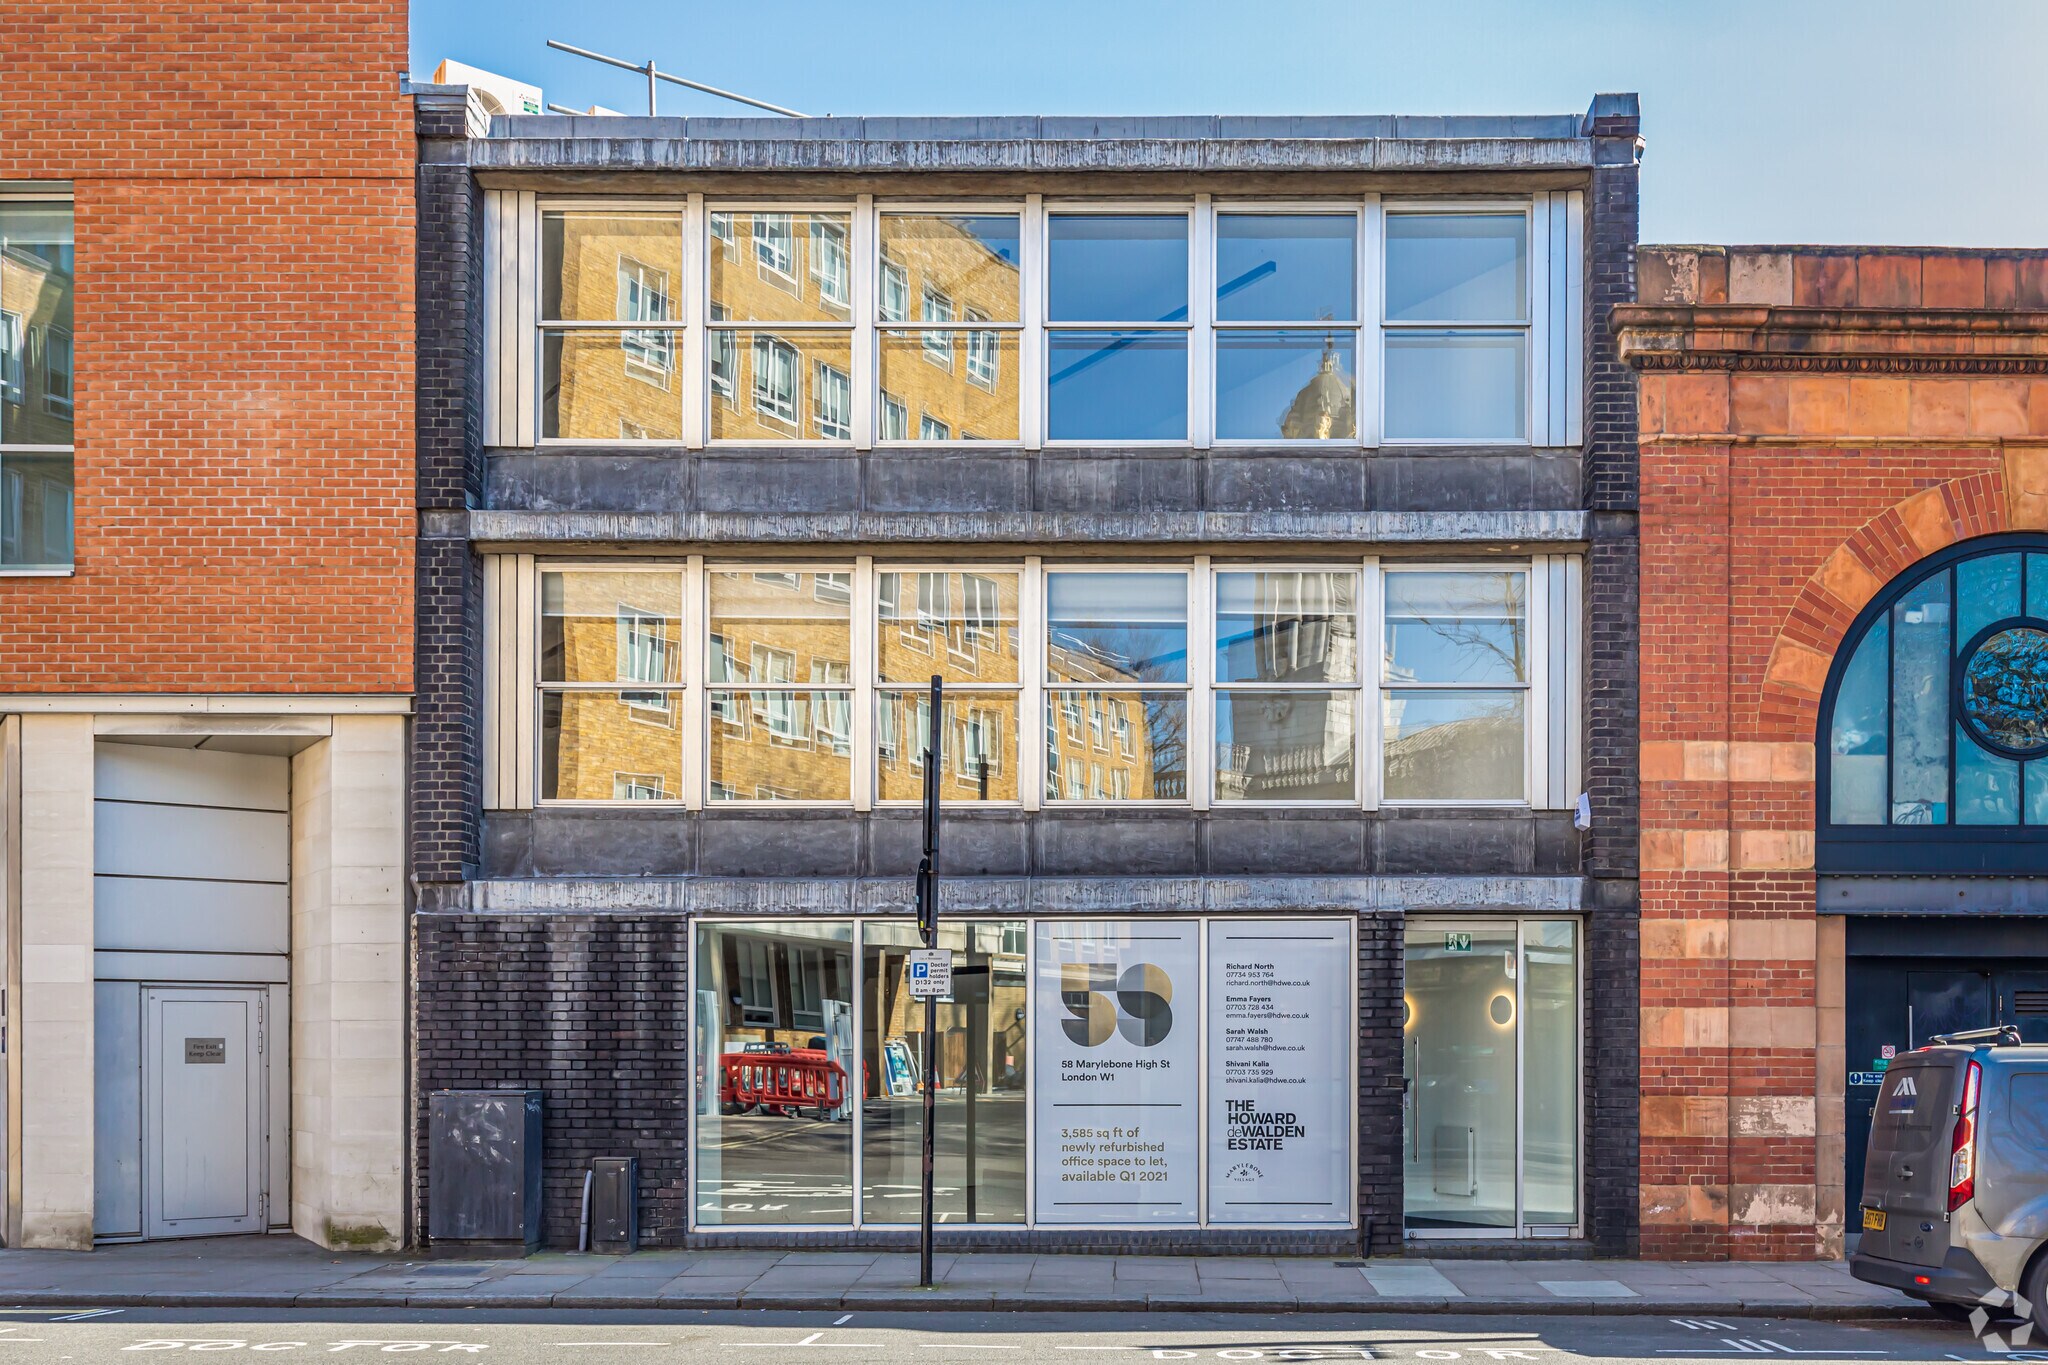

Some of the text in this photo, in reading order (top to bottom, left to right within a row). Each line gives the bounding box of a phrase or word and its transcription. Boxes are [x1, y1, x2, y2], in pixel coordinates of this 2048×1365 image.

[916, 964, 926, 977] P
[1249, 996, 1271, 1004] Fayers
[1061, 1059, 1170, 1070] 58 Marylebone High St
[1061, 1073, 1115, 1081] London W1
[1225, 1099, 1255, 1112] THE
[1228, 1112, 1297, 1125] HOWARD
[1061, 1127, 1140, 1139] 3,585 sq ft of
[1061, 1142, 1165, 1154] newly refurbished
[1227, 1138, 1283, 1150] ESTATE
[1061, 1156, 1168, 1168] office space to let,
[1061, 1170, 1168, 1182] available Q1 2021
[1225, 1163, 1264, 1179] MARYLEBONE
